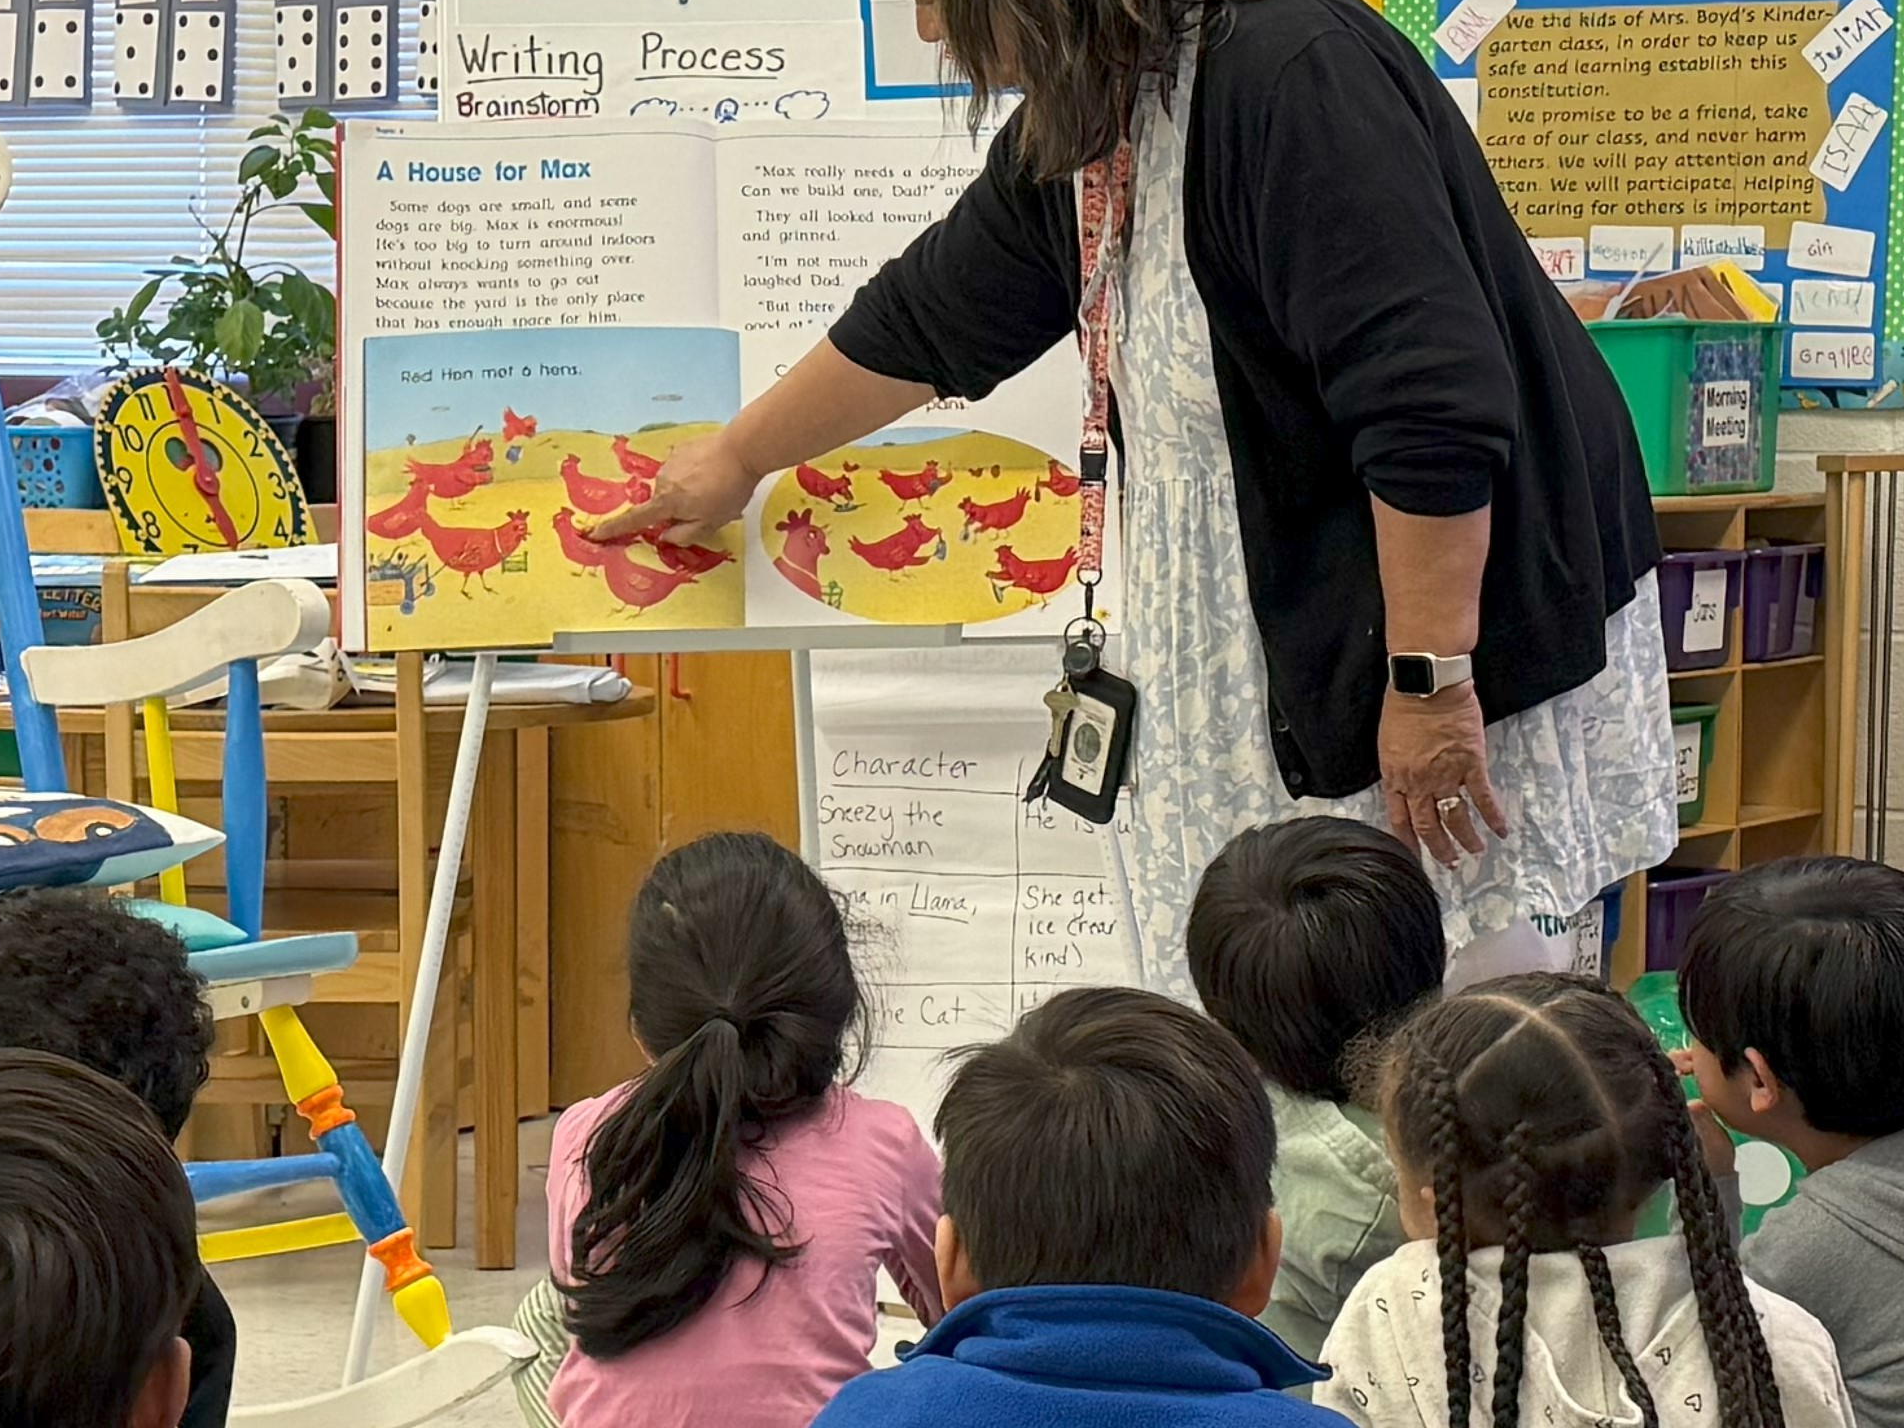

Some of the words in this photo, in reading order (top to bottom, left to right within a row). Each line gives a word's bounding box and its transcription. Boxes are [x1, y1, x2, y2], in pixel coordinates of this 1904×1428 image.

[1505, 9, 1534, 29] We
[1542, 13, 1570, 28] the
[1580, 12, 1616, 27] kids
[1624, 10, 1643, 27] of
[1650, 10, 1690, 27] Mrs.
[1697, 6, 1755, 27] Boyd's
[457, 34, 605, 92] Writing
[640, 31, 787, 75] Process
[1488, 82, 1609, 98] constitution.
[457, 92, 599, 120] Brainstorm
[377, 161, 393, 180] A
[409, 162, 481, 182] House
[496, 161, 527, 181] for
[541, 159, 590, 179] Max
[390, 201, 428, 212] Some
[437, 201, 471, 214] dogs
[479, 203, 502, 212] are
[564, 197, 591, 208] and
[1707, 387, 1747, 410] Morning
[1707, 417, 1745, 439] Meeting
[833, 750, 977, 778] Character
